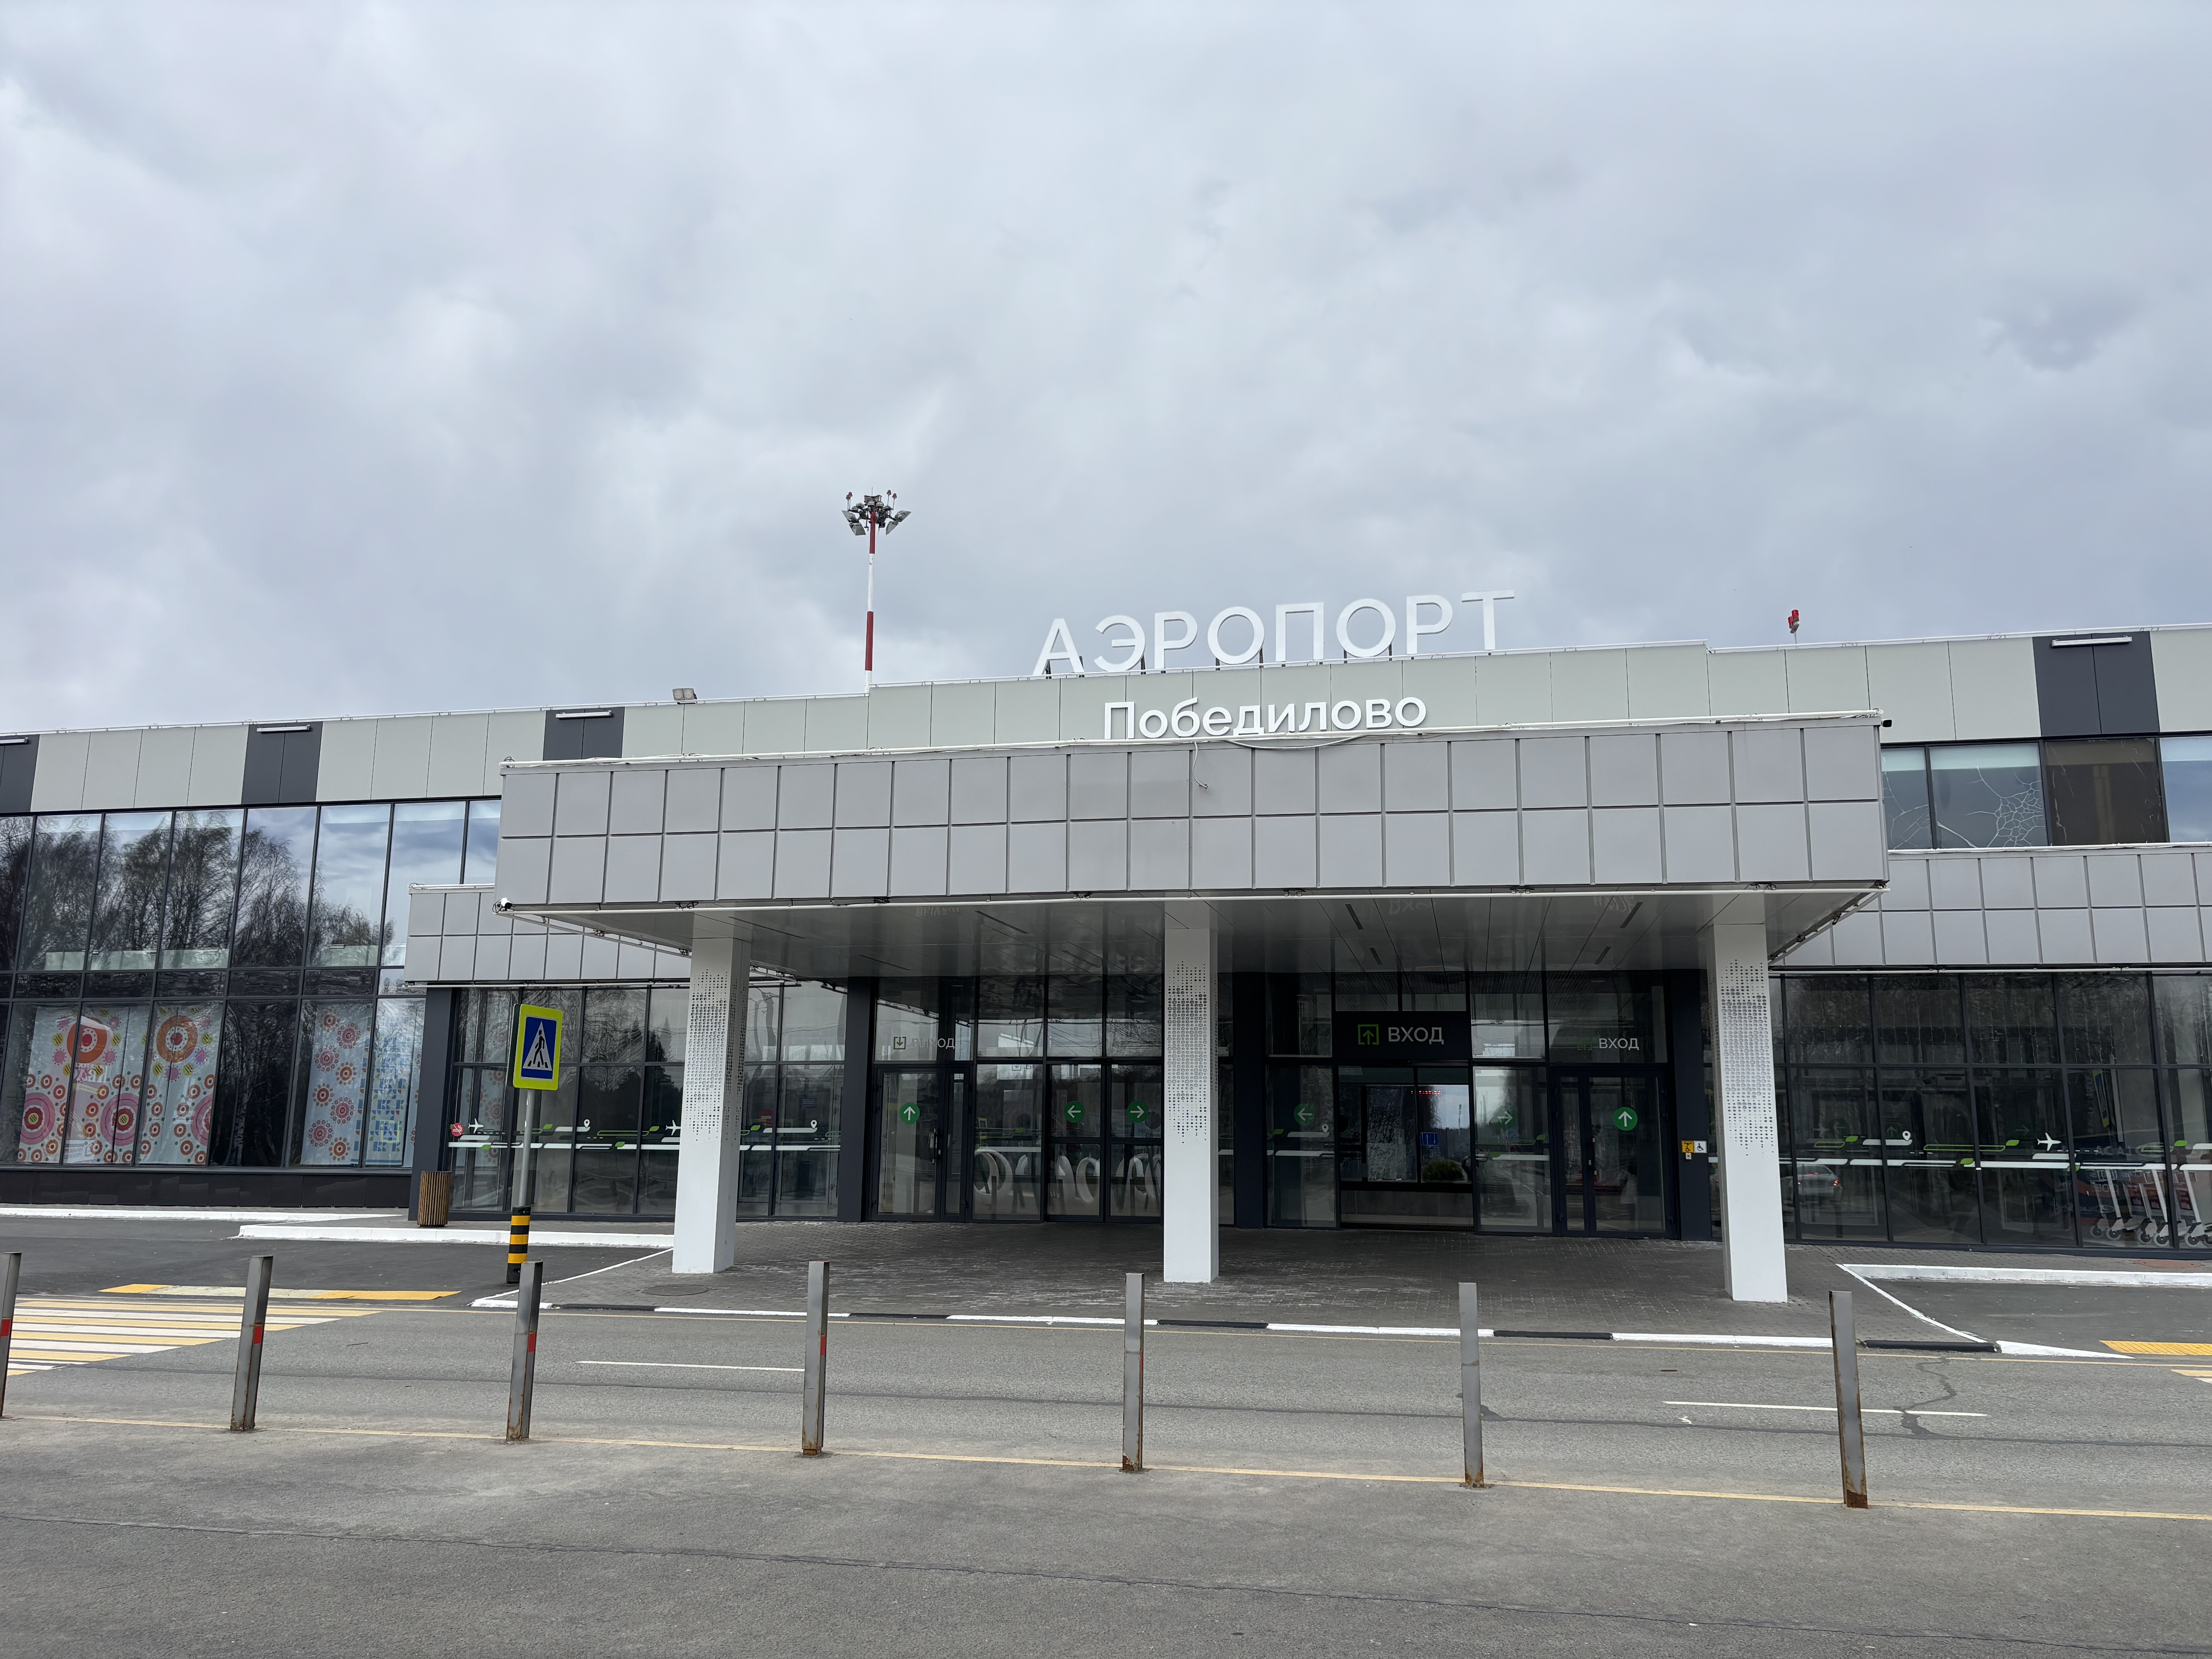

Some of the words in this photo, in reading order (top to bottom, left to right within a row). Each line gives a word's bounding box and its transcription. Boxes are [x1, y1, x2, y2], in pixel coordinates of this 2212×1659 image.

[1033, 589, 1515, 675] АЭРОПОРТ
[1104, 697, 1426, 739] Победилово
[1388, 1027, 1444, 1045] ВХОД
[1599, 1038, 1639, 1051] ВХОД
